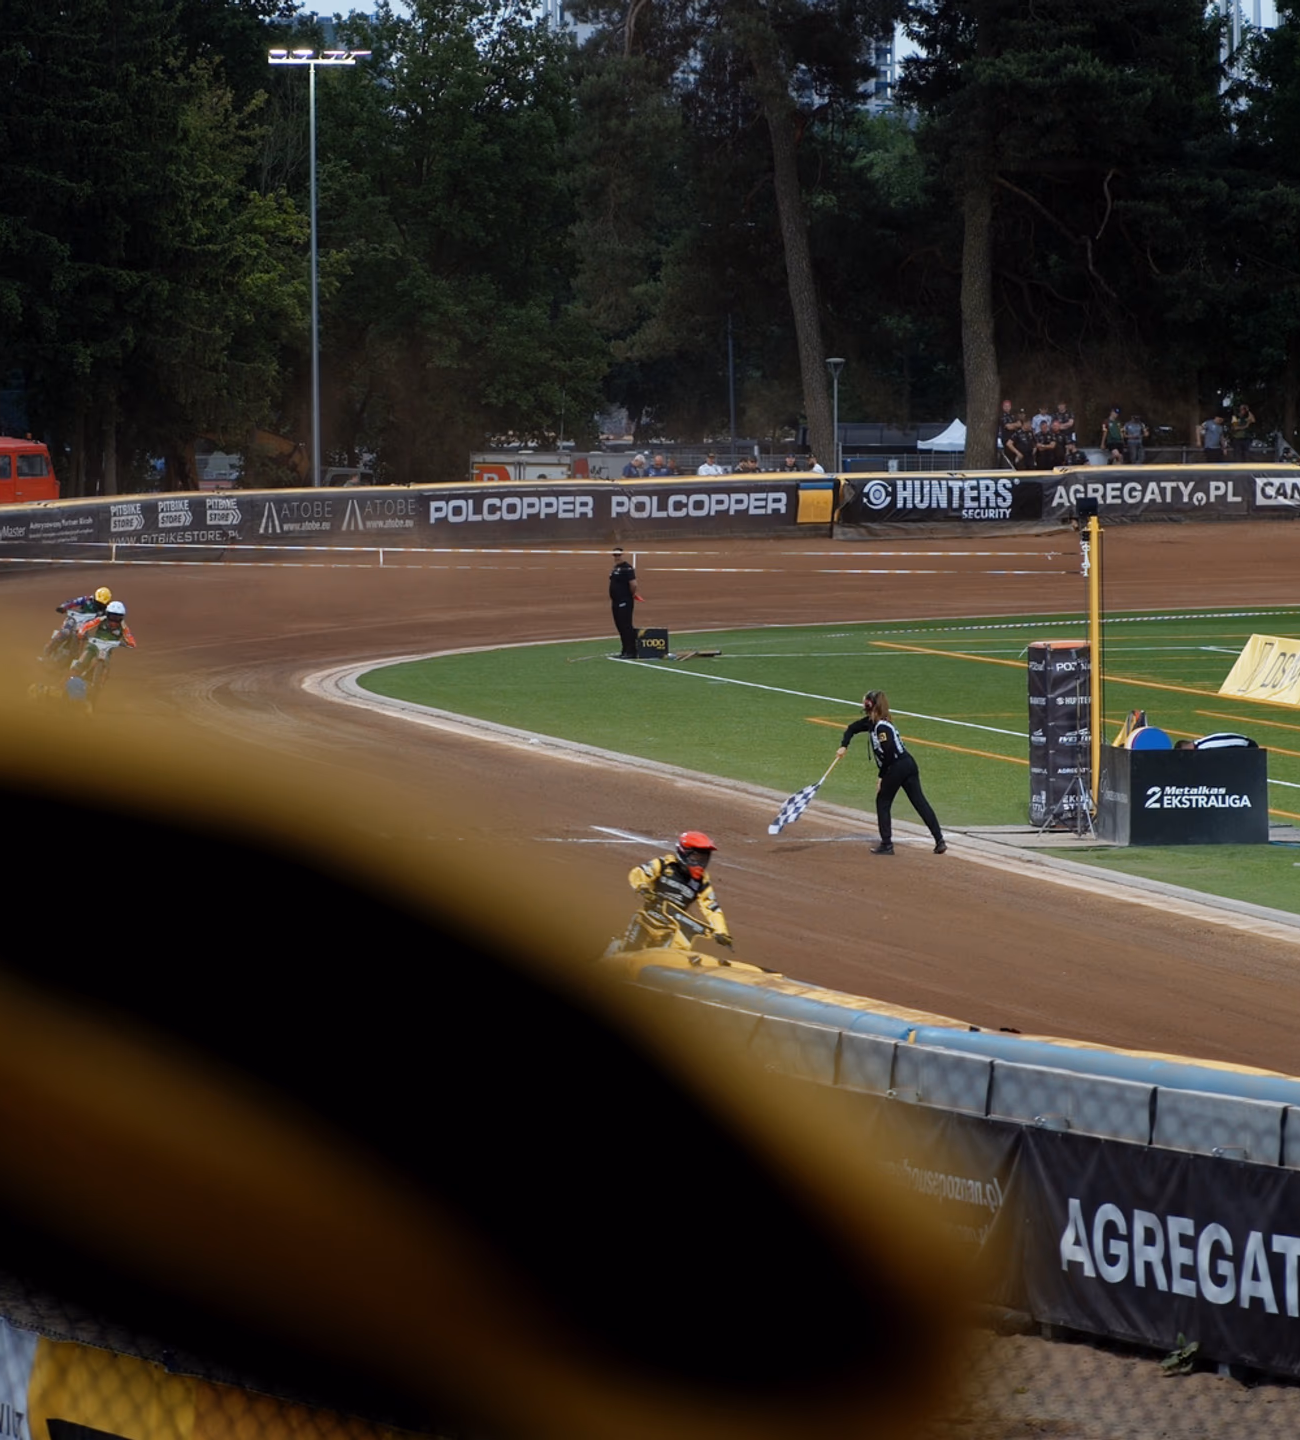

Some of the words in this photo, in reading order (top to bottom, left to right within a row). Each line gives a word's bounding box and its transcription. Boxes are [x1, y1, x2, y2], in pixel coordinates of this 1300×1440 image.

[896, 478, 1014, 510] HUNTERS
[110, 504, 141, 516] PITBIKE
[158, 500, 189, 512] PITBIKE
[206, 499, 237, 510] PITBIKE
[281, 501, 333, 518] ATOBE
[364, 499, 416, 515] ATOBE
[429, 495, 593, 524] POLCOPPER
[611, 492, 786, 519] POLCOPPER
[159, 514, 182, 526] STORE
[208, 512, 231, 523] STORE
[962, 508, 1011, 520] SECURITY
[112, 518, 135, 530] STORE
[283, 520, 332, 531] www.atobe.eu
[366, 519, 414, 529] www.atobe.eu
[1145, 786, 1162, 808] 2
[1164, 786, 1226, 795] Metalkas
[1163, 795, 1252, 808] EKSTRALIGA
